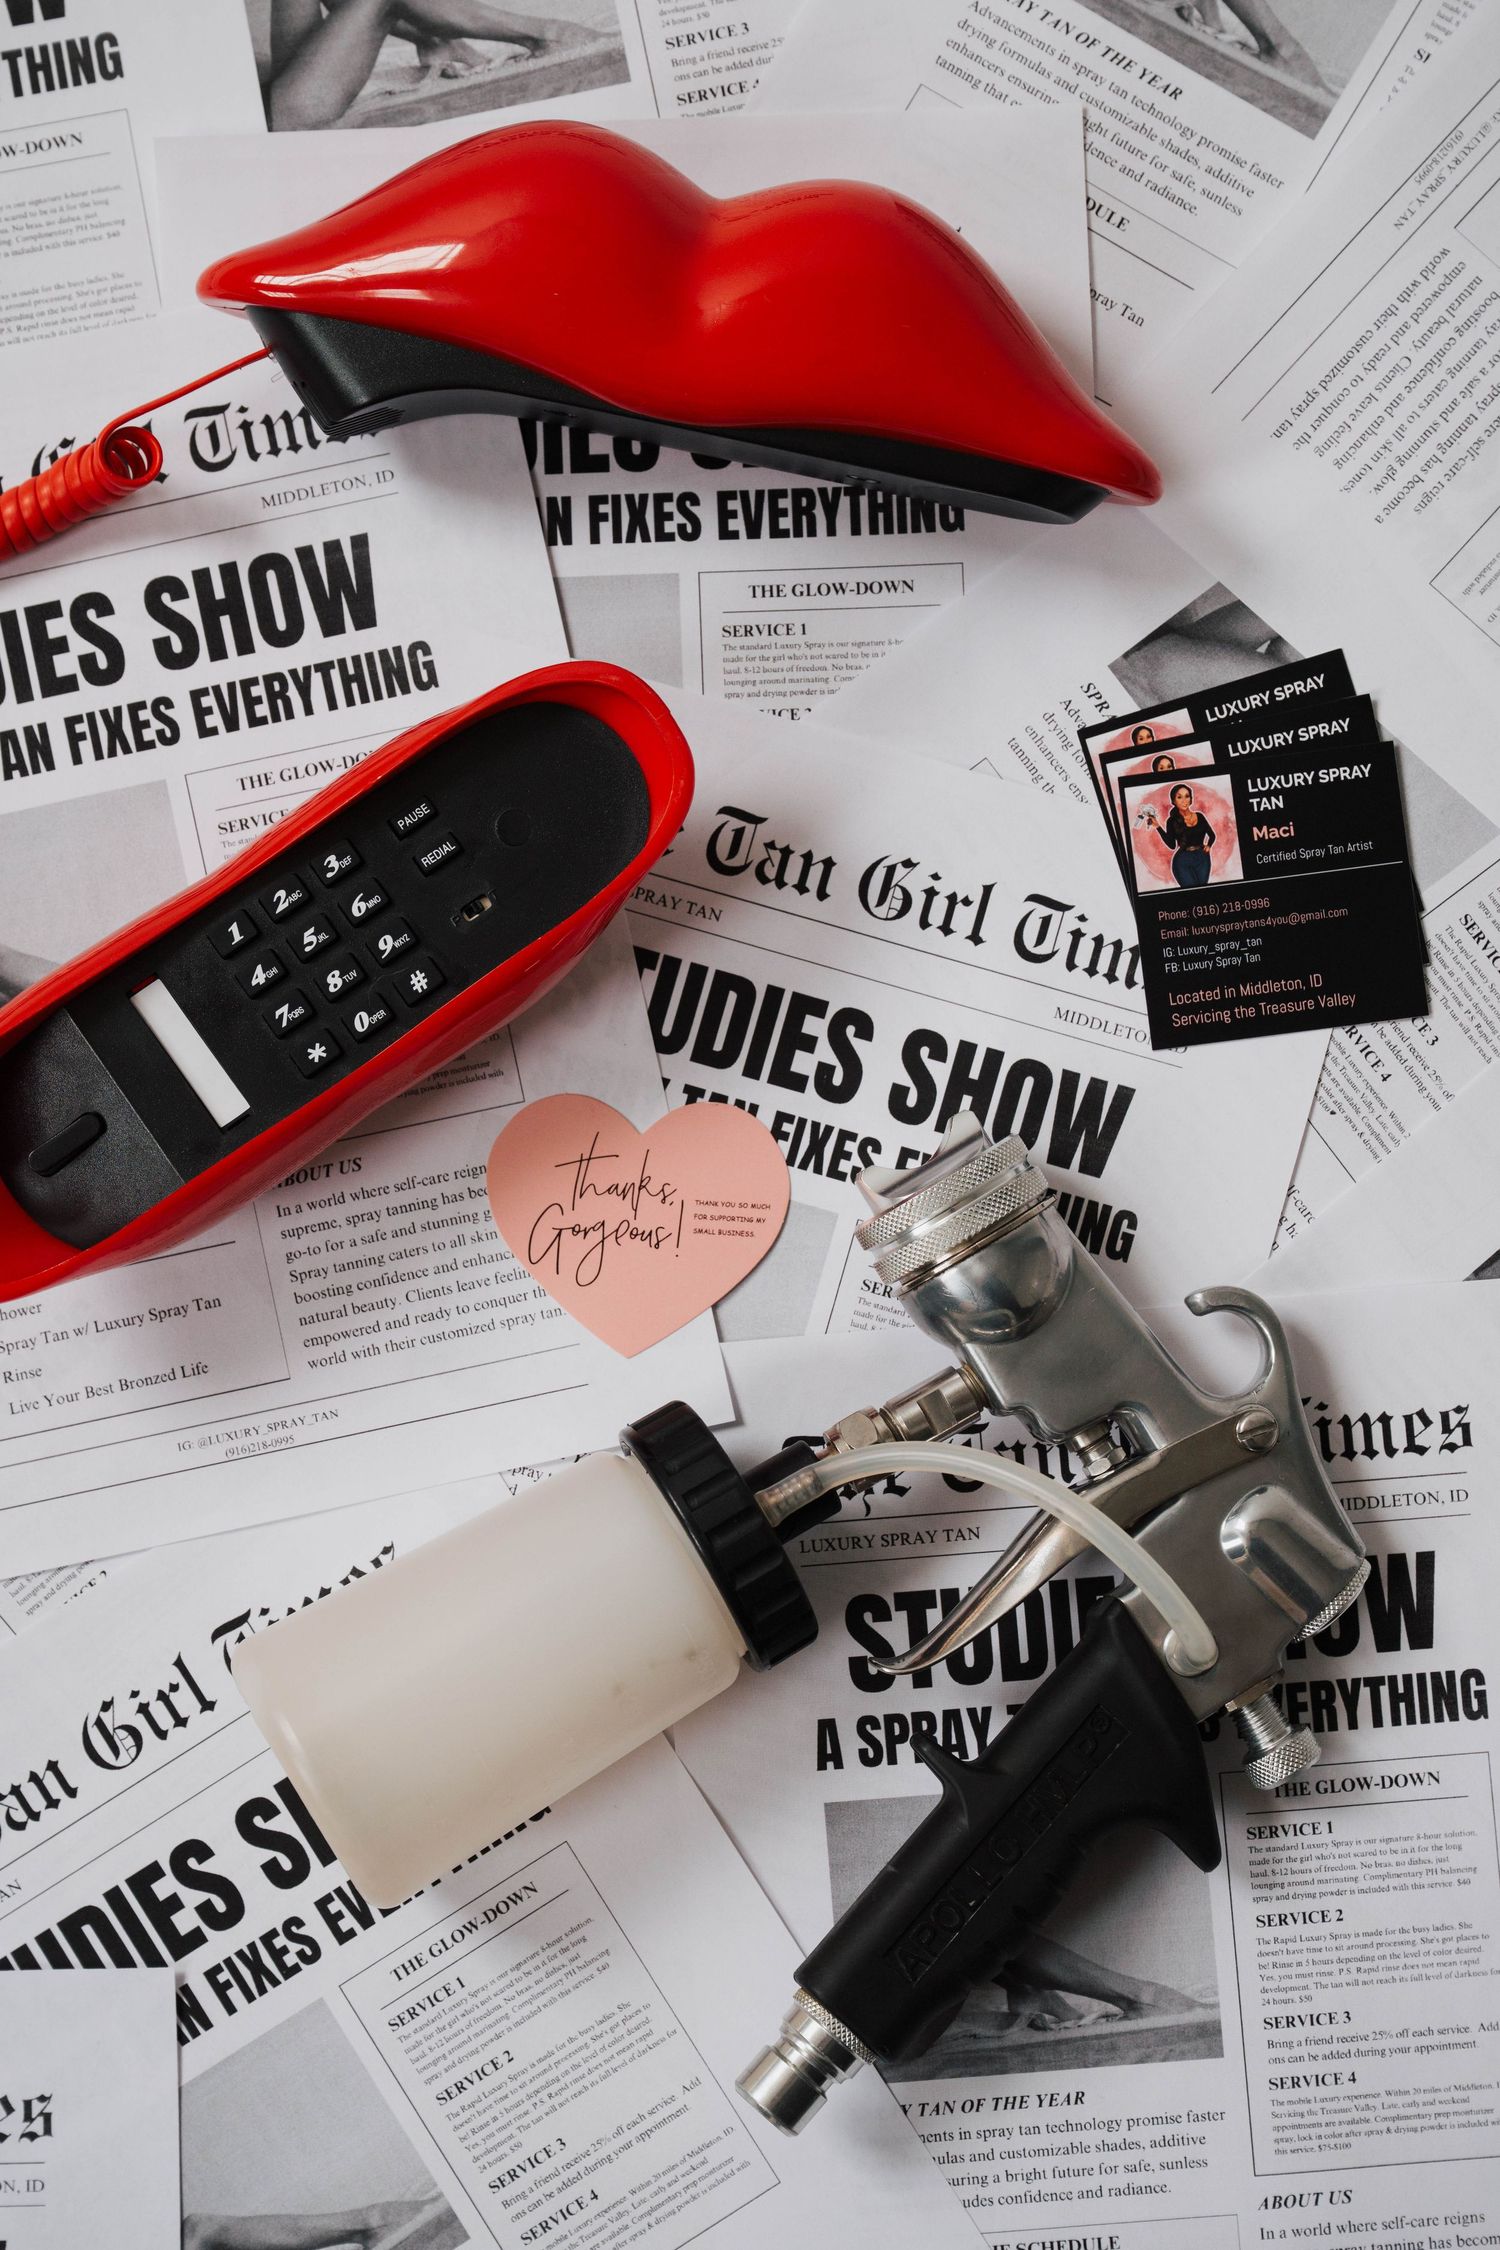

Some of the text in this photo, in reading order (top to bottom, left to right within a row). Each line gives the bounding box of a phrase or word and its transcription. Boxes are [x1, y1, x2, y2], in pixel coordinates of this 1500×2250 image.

[664, 21, 750, 50] SERVICE 3
[967, 0, 1285, 189] Advancements in spray tan technology promise faster
[1269, 247, 1450, 438] world with their customized spray tan.
[260, 469, 395, 509] MIDDLETON, ID
[589, 487, 965, 545] FIXES EVERYTHING
[748, 579, 914, 598] THE GLOW-DOWN
[0, 532, 377, 704] IES SHOW
[721, 622, 806, 638] SERVICE 1
[63, 696, 181, 766] FIXES
[189, 640, 439, 739] EVERYTHING
[1204, 672, 1324, 723] LUXURY SPRAY
[1227, 716, 1350, 757] LUXURY SPRAY
[1247, 762, 1372, 793] LUXURY SPRAY
[397, 803, 431, 831] PAUSE
[1248, 794, 1284, 812] TAN
[1252, 820, 1295, 841] Maci
[323, 854, 353, 878] 3 DEF
[421, 841, 456, 868] REDIAL
[1255, 840, 1374, 864] Certified Spray Tan Artist
[273, 889, 303, 914] 2 ABC
[351, 893, 382, 917] 6 MNO
[705, 806, 1143, 990] Tan Girl Tim
[1157, 896, 1270, 921] Phone: (916) 218-0996
[228, 922, 245, 946] 1
[1159, 907, 1348, 940] Email: luxuryspraytans4you@gmail.com
[303, 927, 330, 952] 5 JKL
[377, 932, 411, 959] 9 WXYZ
[1162, 937, 1263, 958] IG: Luxury_spray_tan
[251, 964, 279, 987] 4 GHI
[1164, 952, 1261, 973] FB: Luxury Spray Tan
[326, 969, 358, 993] 8 TUV
[1168, 972, 1323, 1006] Located in Middleton, ID
[275, 1003, 305, 1028] 7 PQRS
[354, 1009, 388, 1033] 0 OPER
[1171, 992, 1356, 1027] Servicing the Treasure Valley
[887, 1028, 1136, 1179] SHOW
[772, 1117, 882, 1185] FIXES
[694, 1199, 719, 1208] THANK
[721, 1200, 736, 1208] YOU
[693, 1213, 708, 1221] FOR
[709, 1214, 754, 1224] SUPPORTING
[693, 1228, 716, 1236] SMALL
[528, 1200, 687, 1287] Gorgeous!
[8, 1360, 208, 1415] Live Your Best Bronzed Life
[176, 1408, 339, 1452] IG: @LUXURY_SPRAY_TAN
[1303, 1400, 1474, 1463] imes
[224, 1434, 295, 1459] (916)218-0995
[1450, 1489, 1468, 1502] ID
[799, 1525, 981, 1554] LUXURY SPRAY TAN
[845, 1576, 1115, 1693] STUDI
[82, 1652, 218, 1770] Girl
[1277, 1667, 1488, 1735] ERYTHING
[816, 1705, 993, 1771] A SPRAY
[1315, 1771, 1440, 1794] GLOW-DOWN
[1246, 1820, 1333, 1840] SERVICE 1
[390, 1951, 429, 1981] THE
[428, 1881, 538, 1958] GLOW-DOWN
[1255, 1908, 1344, 1928] SERVICE 2
[202, 1915, 322, 2016] FIXES
[387, 1976, 465, 2032] SERVICE 1
[1262, 2010, 1351, 2030] SERVICE 3
[435, 2049, 514, 2106] SERVICE 2
[1268, 2070, 1357, 2091] SERVICE 4
[917, 2090, 1085, 2117] TAN OF THE YEAR
[487, 2137, 566, 2194] SERVICE 3
[1257, 2188, 1353, 2210] ABOUT US
[519, 2188, 599, 2246] SERVICE 4
